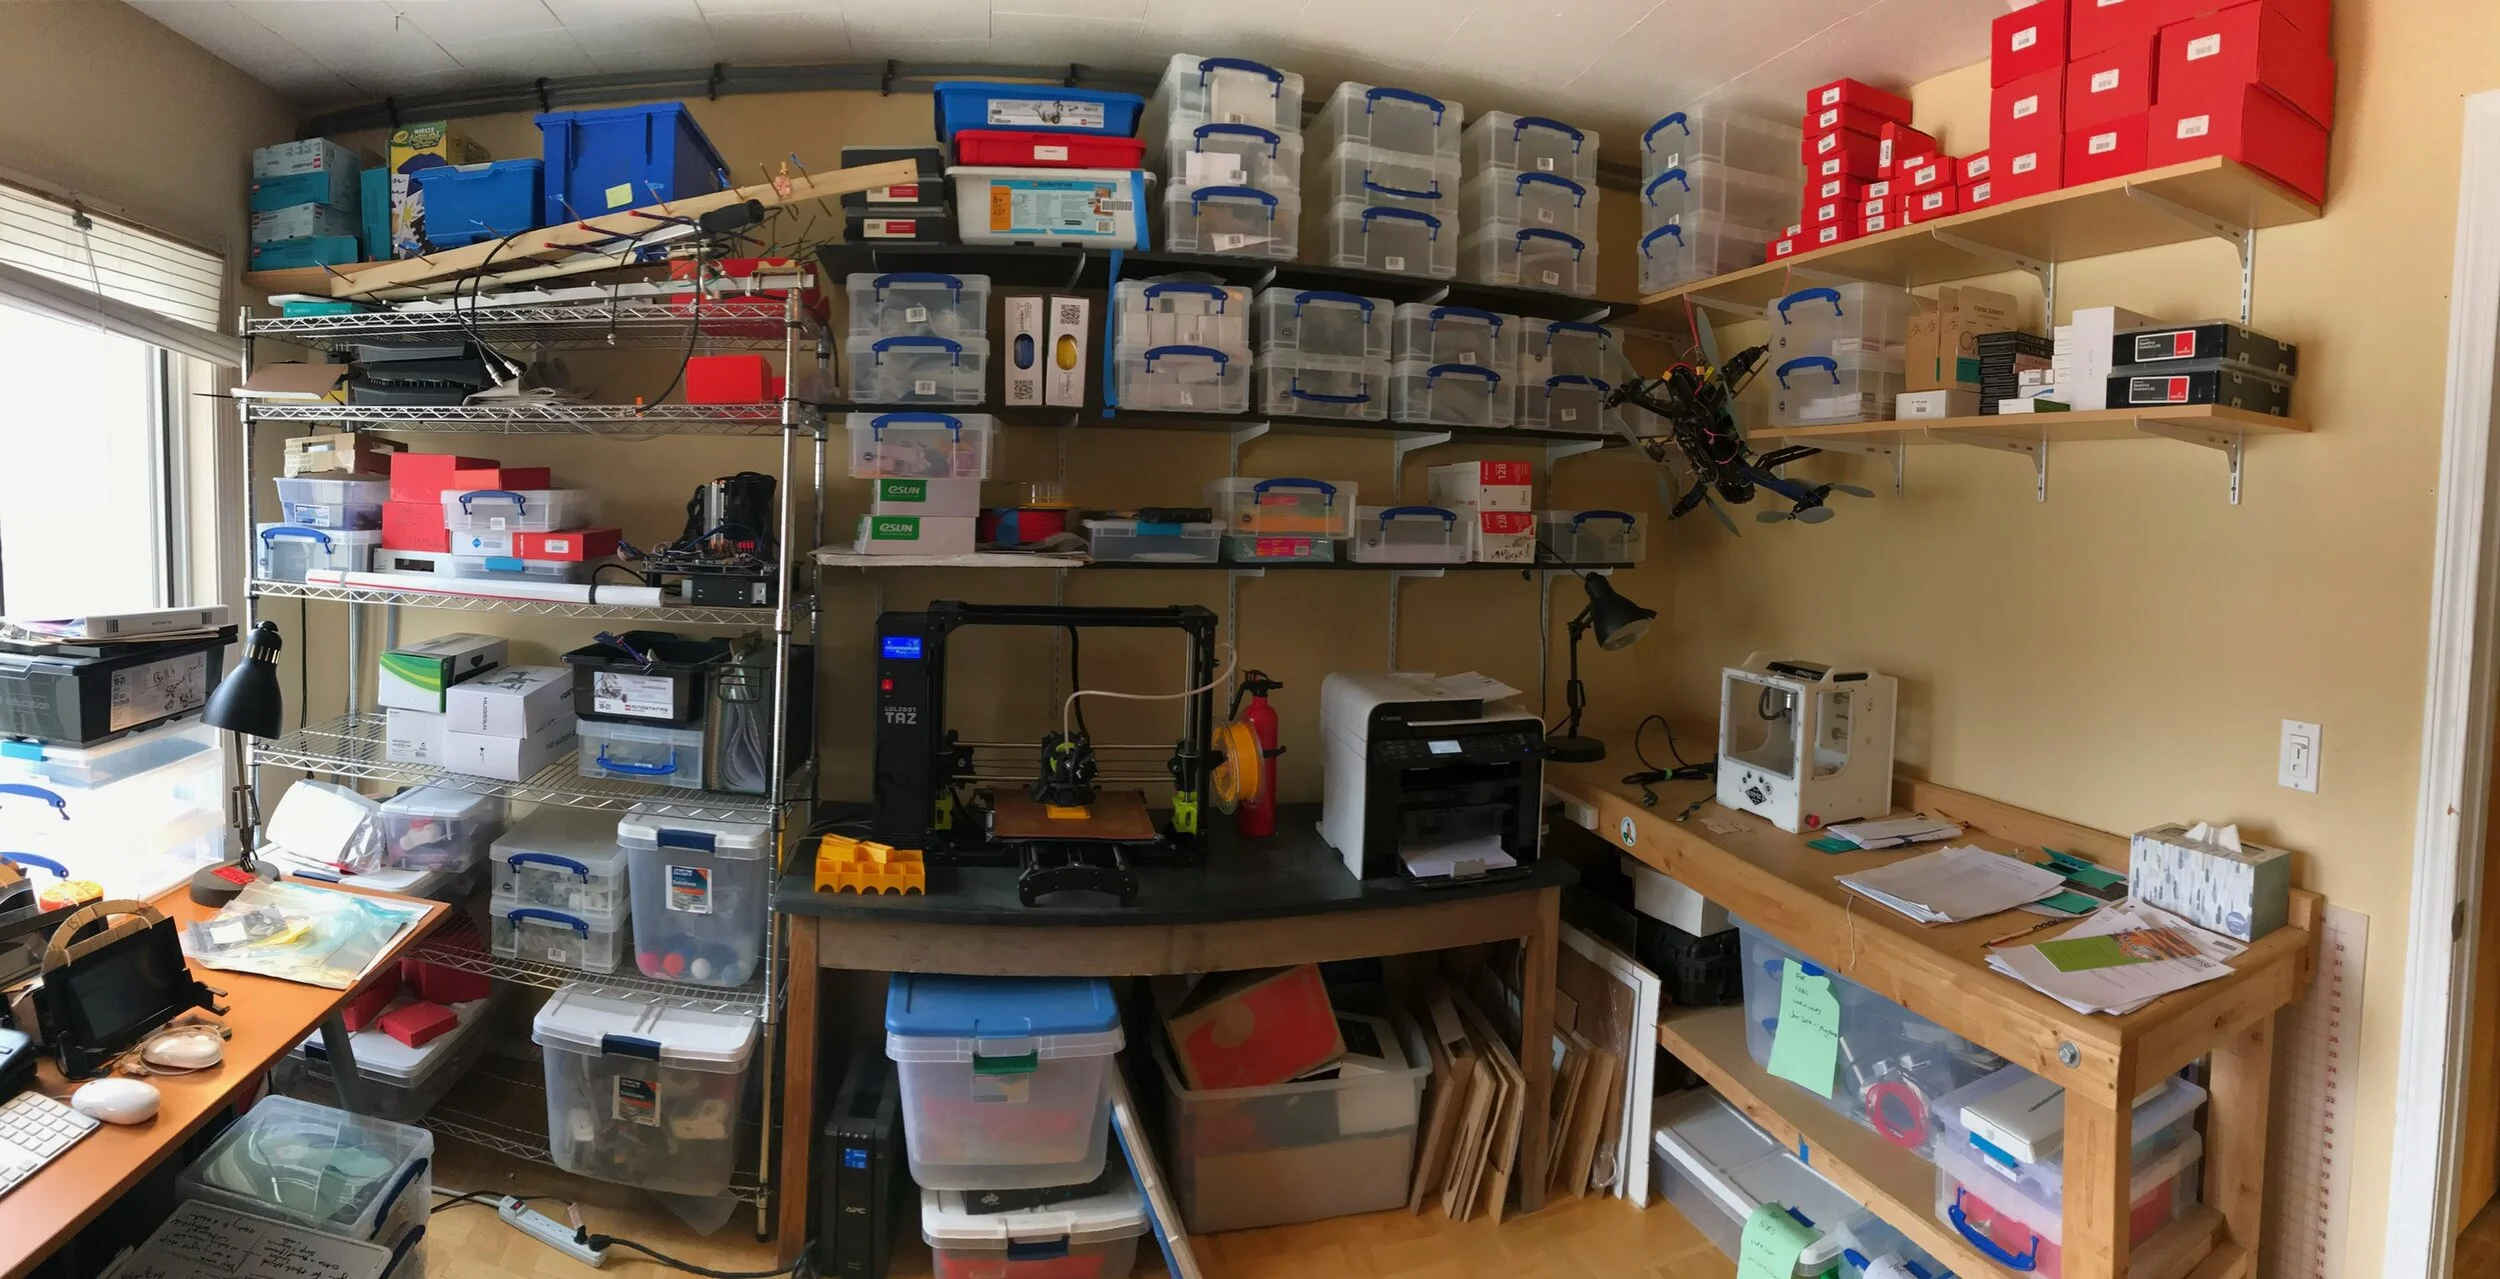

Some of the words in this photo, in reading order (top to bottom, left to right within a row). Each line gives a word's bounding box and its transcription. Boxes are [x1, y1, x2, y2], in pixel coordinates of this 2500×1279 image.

[1497, 463, 1507, 480] 128
[888, 485, 920, 495] eSUN
[1498, 514, 1508, 529] 128
[879, 523, 913, 533] eSUN
[885, 712, 917, 724] TAZ
[845, 1206, 867, 1215] APC
